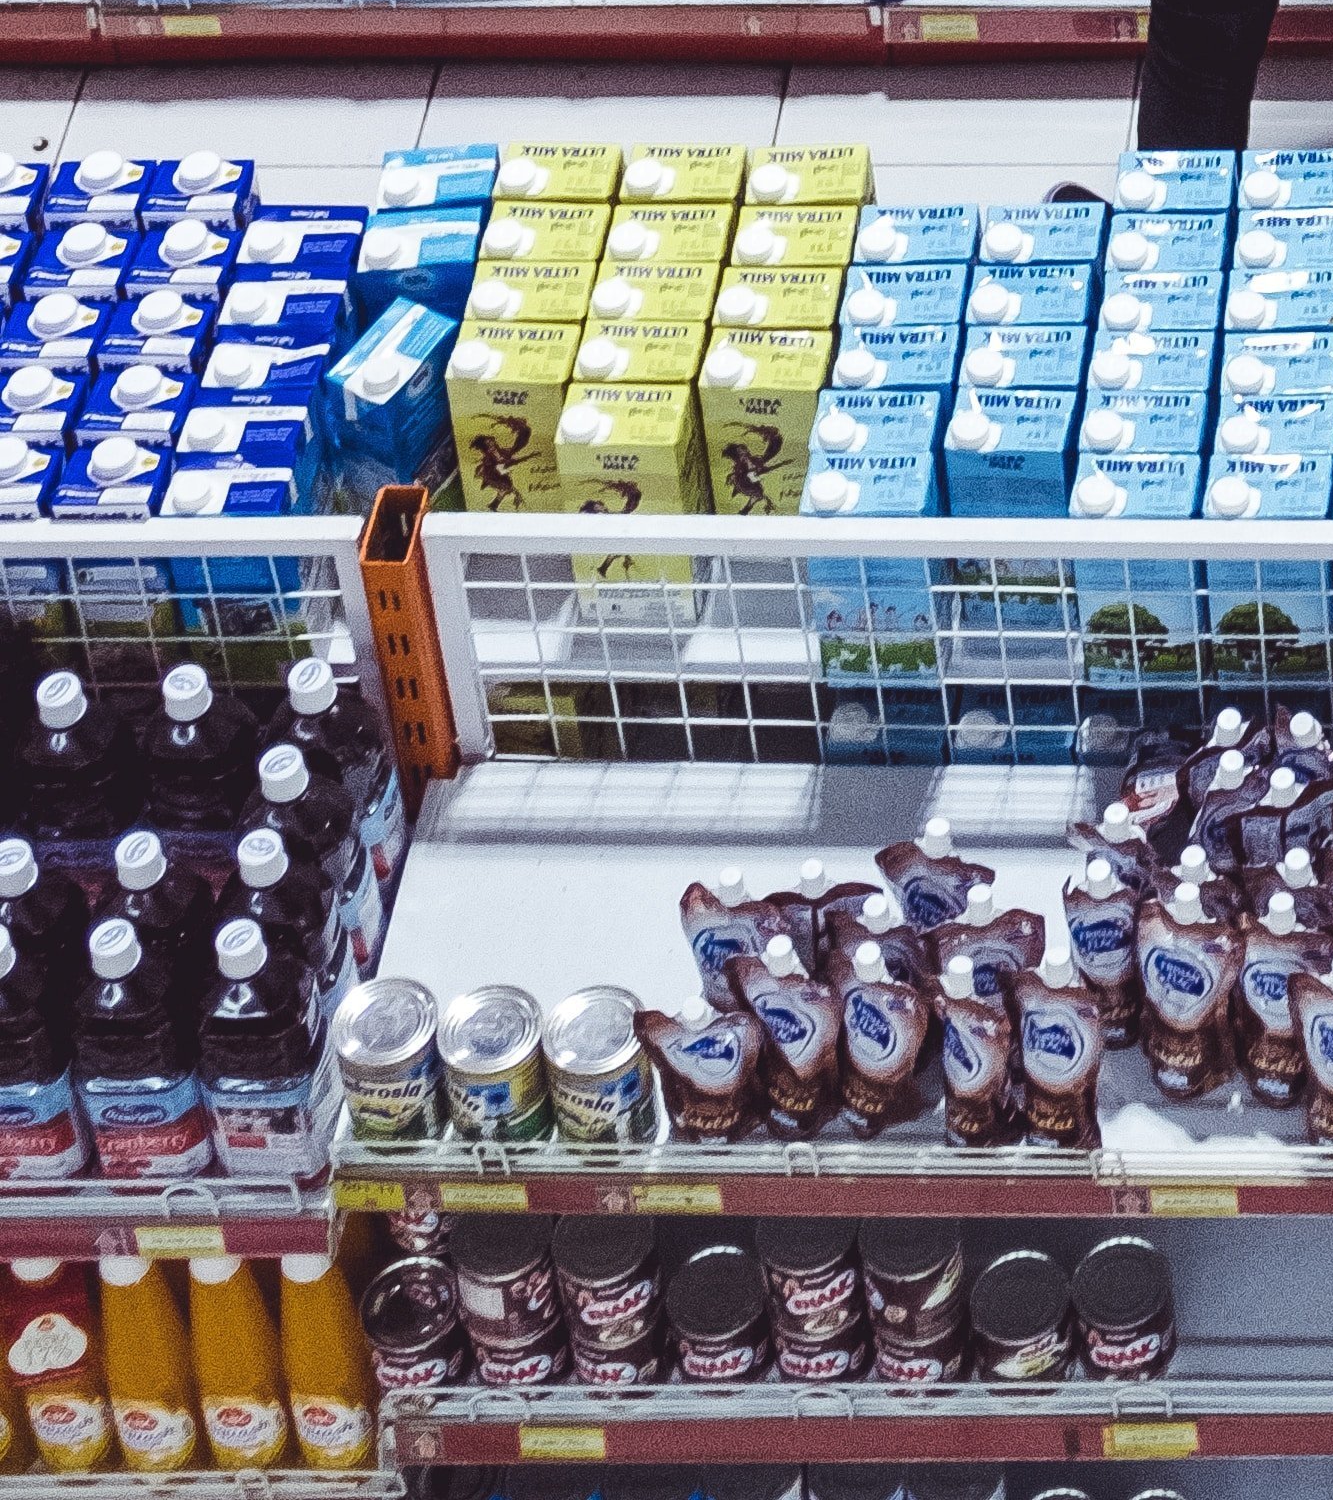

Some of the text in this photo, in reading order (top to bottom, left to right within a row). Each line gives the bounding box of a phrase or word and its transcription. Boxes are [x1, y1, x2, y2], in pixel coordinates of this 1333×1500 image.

[520, 144, 608, 158] ULTRA MILK
[643, 144, 733, 158] ULTRA MILK
[506, 206, 596, 221] ULTRA MILK
[629, 206, 720, 221] ULTRA MILK
[490, 265, 580, 279] ULTRA MILK
[614, 265, 703, 279] ULTRA MILK
[492, 395, 527, 407] MILK
[744, 403, 779, 416] MILK
[600, 461, 638, 471] MILK
